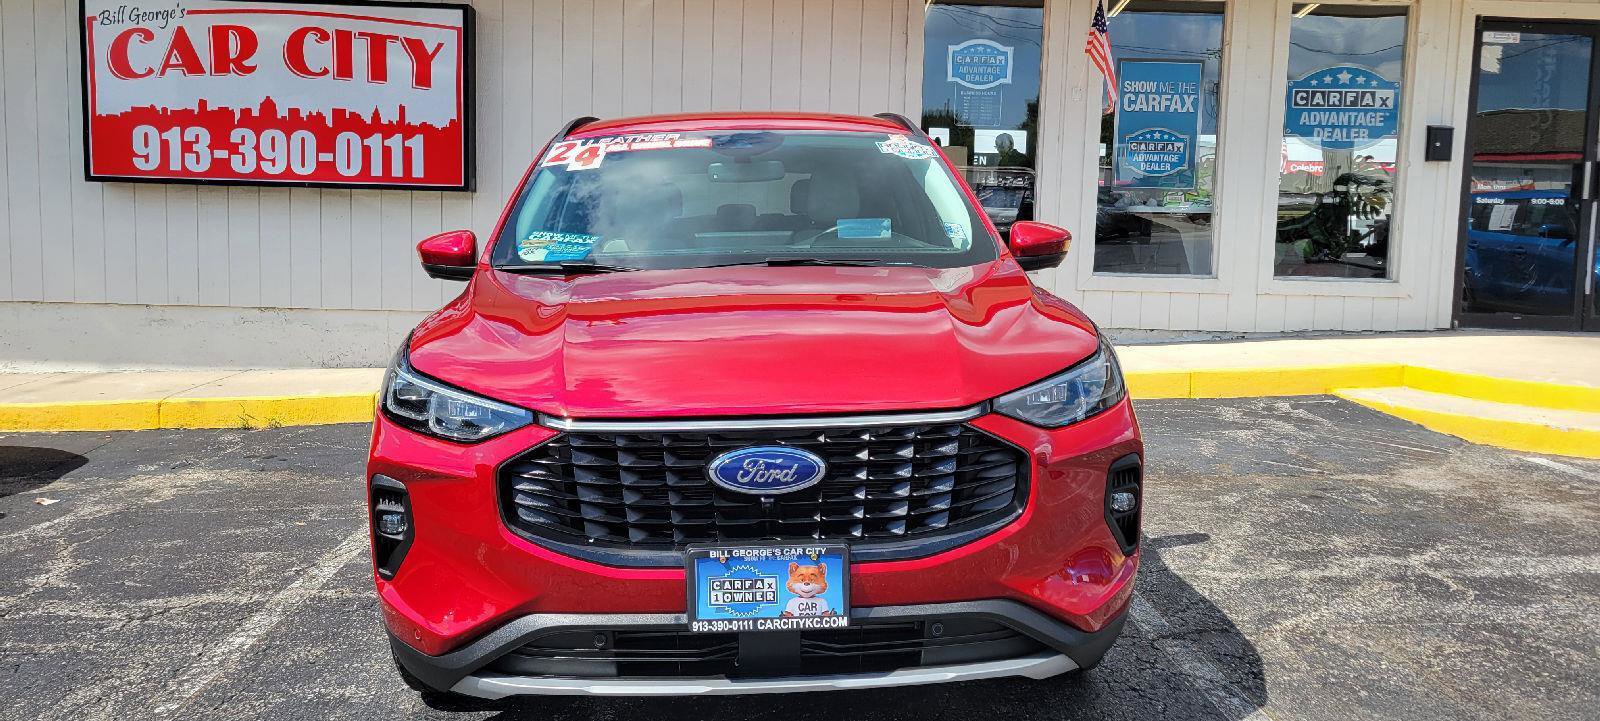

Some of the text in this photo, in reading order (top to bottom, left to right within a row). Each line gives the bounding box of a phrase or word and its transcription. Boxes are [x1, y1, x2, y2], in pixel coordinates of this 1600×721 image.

[98, 3, 185, 29] Bill George's
[107, 24, 445, 91] CAR CITY
[956, 55, 1005, 65] CARFAX
[959, 66, 1001, 74] ADVANTAGE
[966, 74, 994, 82] DEALER
[1124, 80, 1197, 94] SHOW ME THE
[1123, 93, 1196, 113] CARFAX
[1295, 92, 1390, 108] CARFAX
[1299, 111, 1385, 127] ADVANTAGE
[1313, 128, 1369, 142] DEALER
[132, 124, 424, 178] 913-390-0111
[1130, 142, 1183, 152] CARFAX
[1132, 153, 1179, 162] ADVANTAGE
[1140, 162, 1171, 171] DEALER
[1476, 197, 1505, 205] Saturday
[737, 458, 799, 483] Ford
[710, 547, 827, 559] BILL GEORGE'S CAR CITY
[712, 579, 775, 590] CARFAX
[798, 602, 818, 612] CAR
[692, 616, 848, 632] 913-390-0111 CARCITYKC.COM
